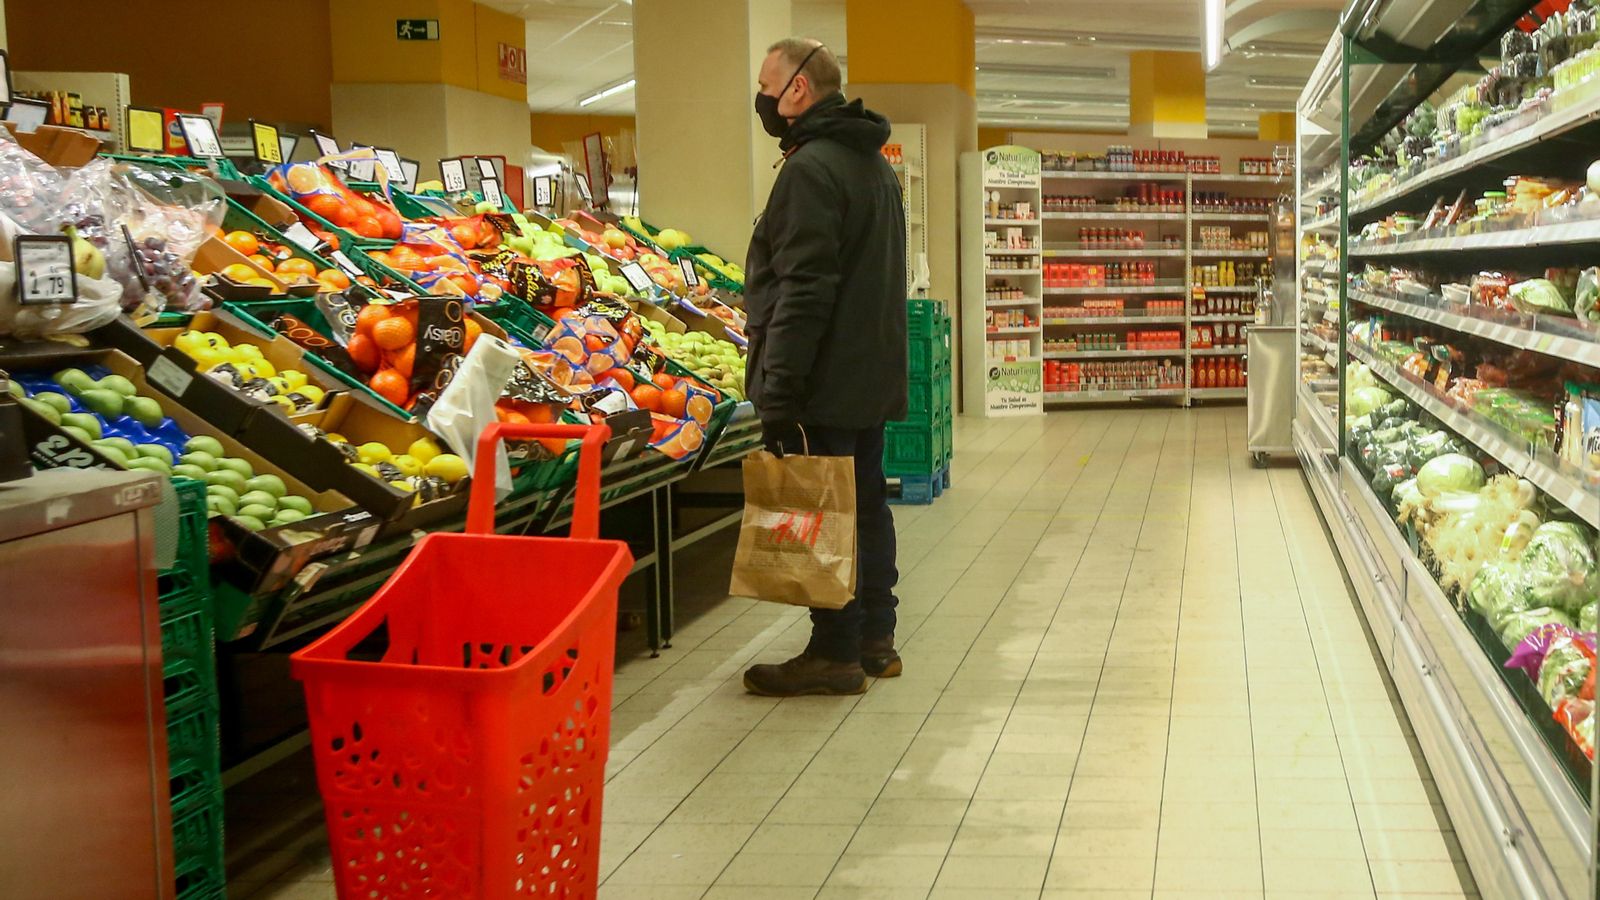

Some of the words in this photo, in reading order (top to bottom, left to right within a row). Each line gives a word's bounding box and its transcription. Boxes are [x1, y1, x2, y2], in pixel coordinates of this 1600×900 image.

[524, 265, 541, 303] Solita
[423, 324, 461, 344] daisy
[1001, 367, 1040, 377] NaturTierra
